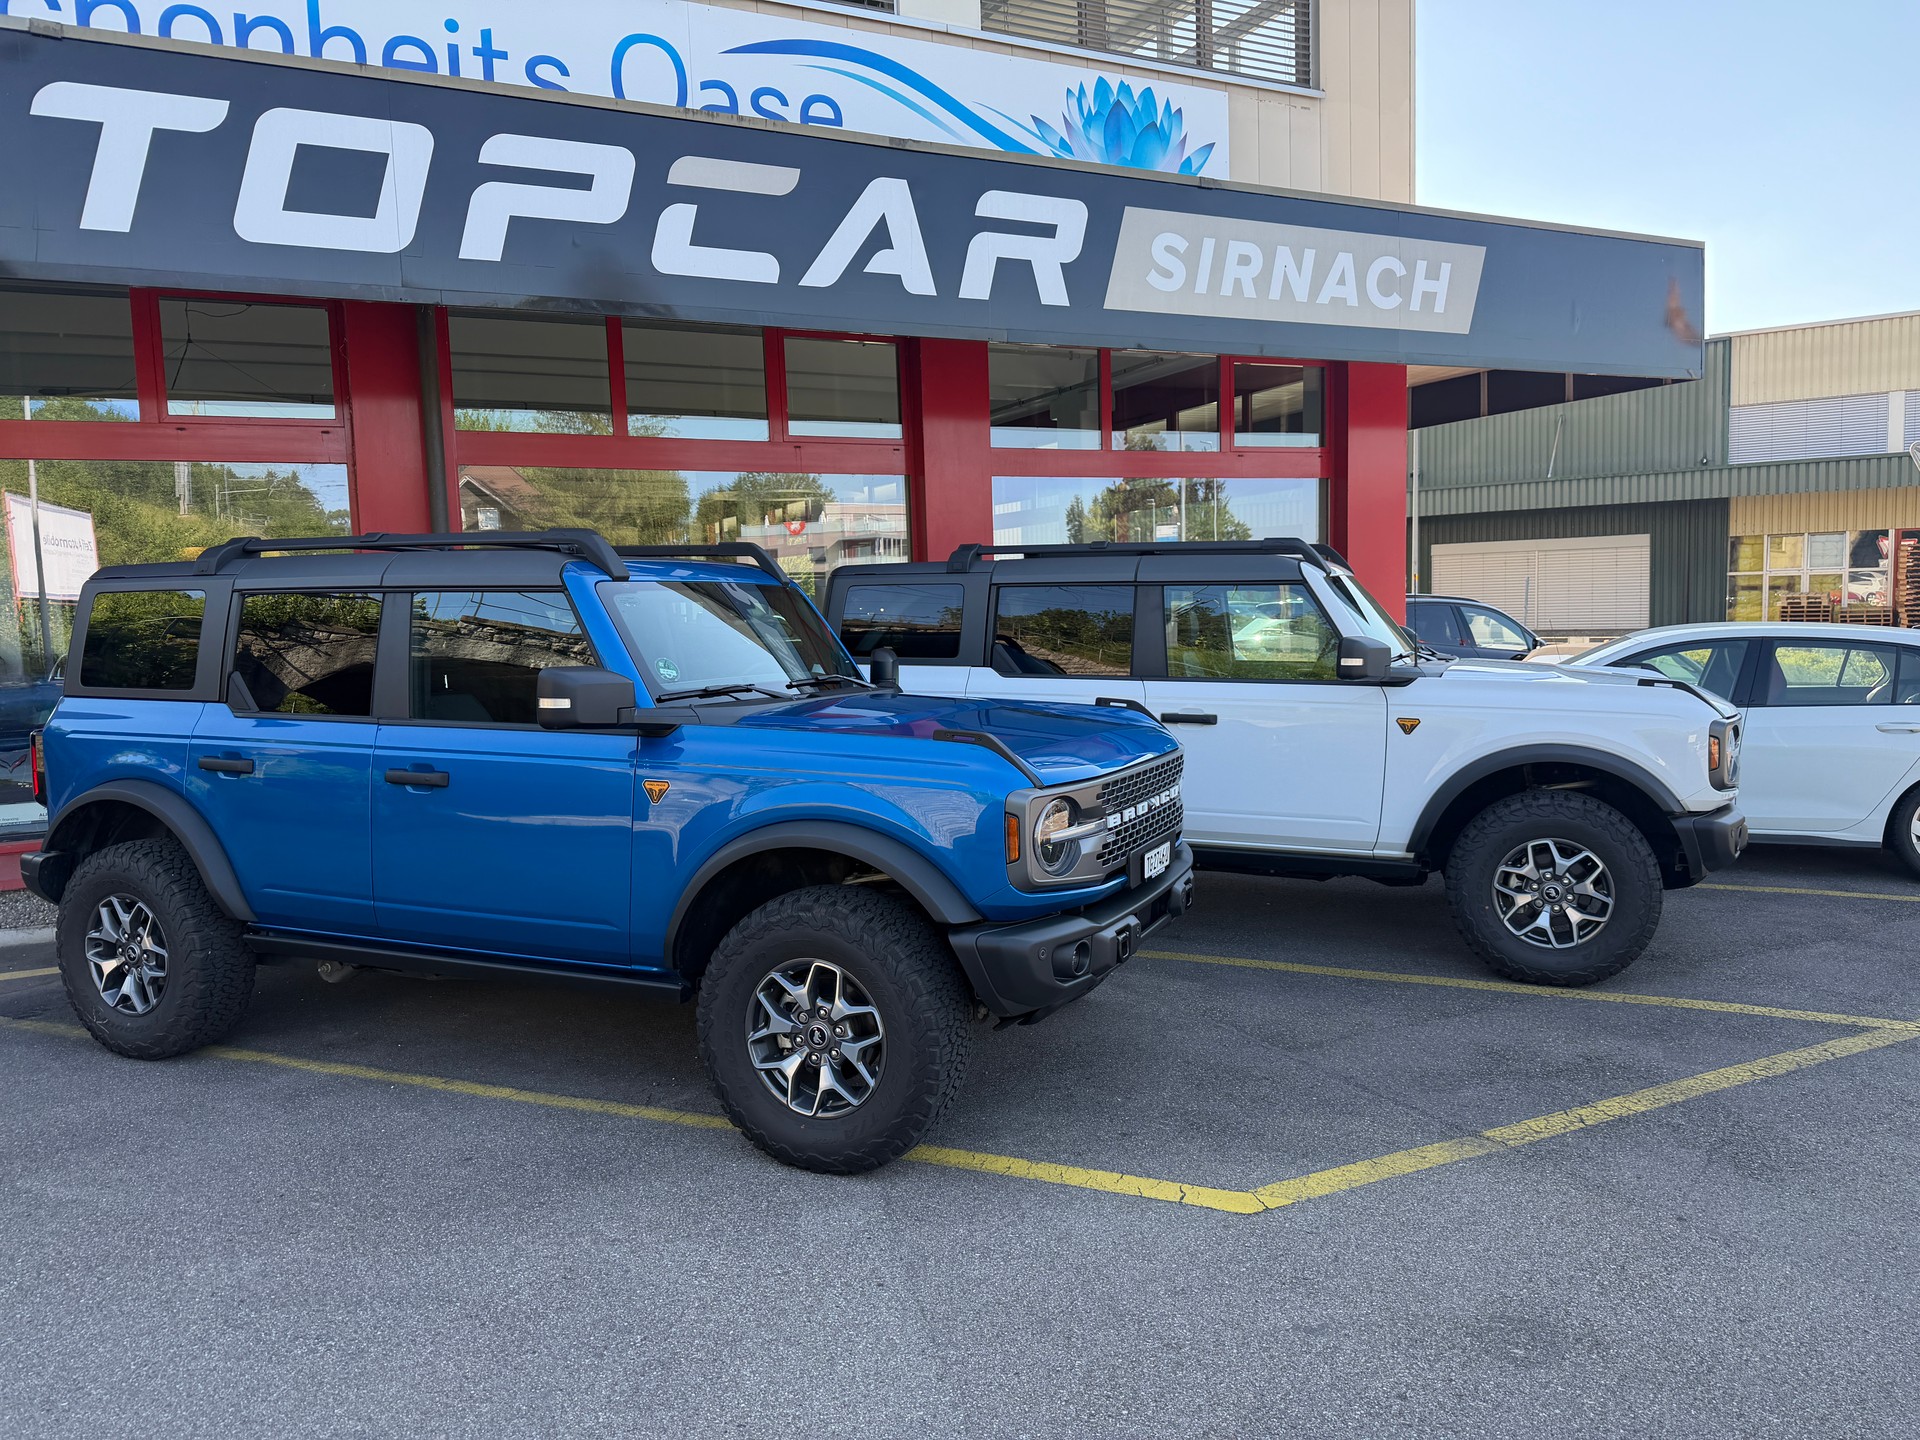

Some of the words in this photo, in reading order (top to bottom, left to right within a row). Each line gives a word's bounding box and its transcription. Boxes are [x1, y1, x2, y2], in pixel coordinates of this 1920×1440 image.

[30, 81, 1089, 307] TOPCAR
[1145, 232, 1452, 314] SIRNACH
[1106, 784, 1181, 829] BRONCO
